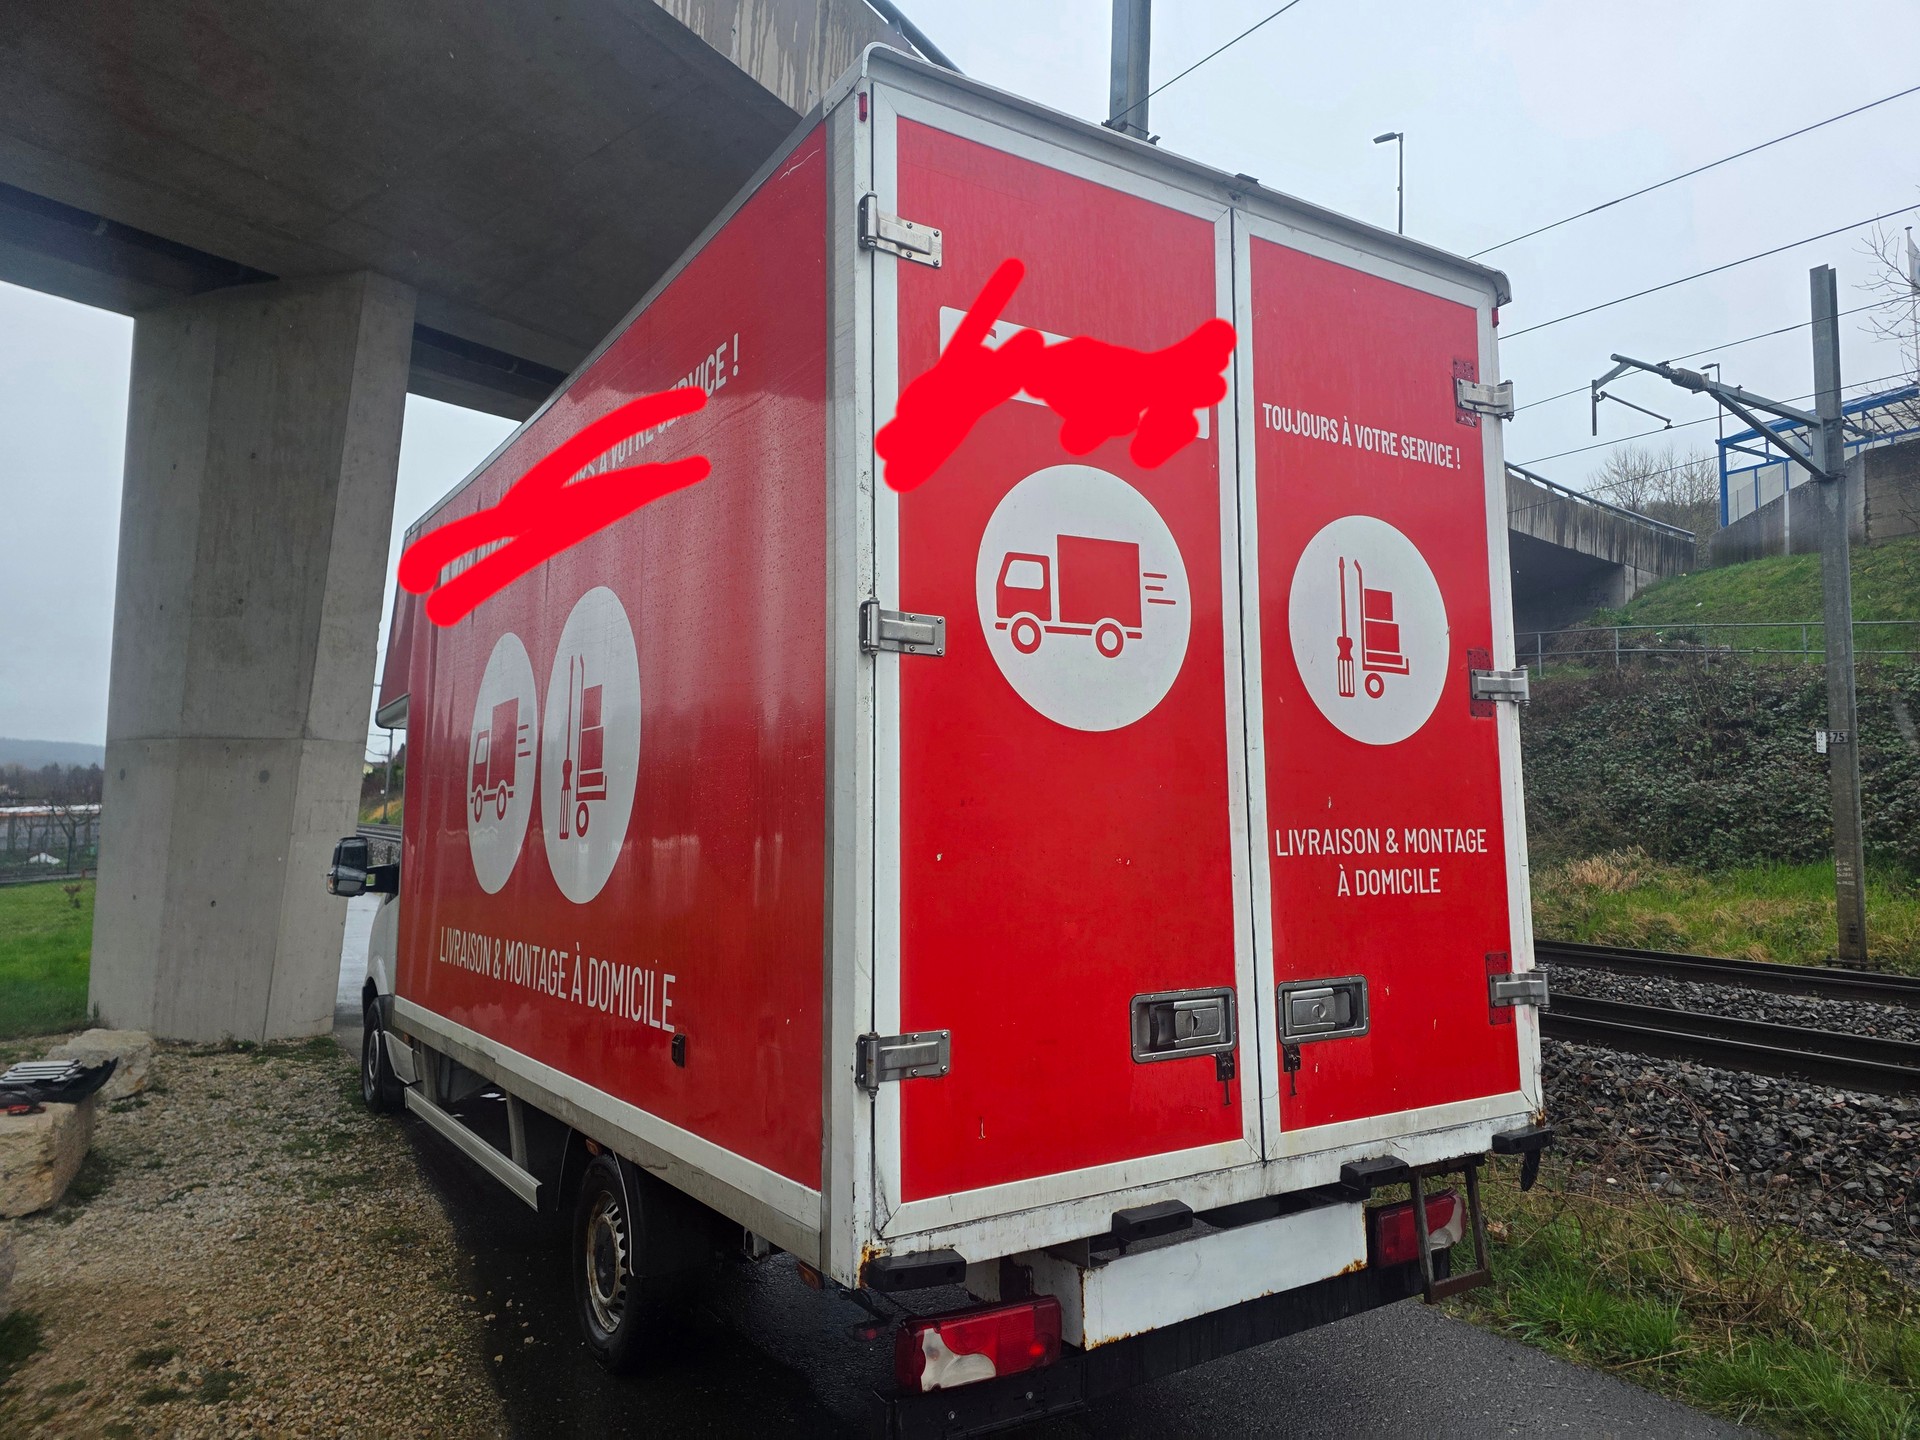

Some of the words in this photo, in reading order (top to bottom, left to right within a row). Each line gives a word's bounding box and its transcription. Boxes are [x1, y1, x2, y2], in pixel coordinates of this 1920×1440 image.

[733, 332, 739, 377] !
[1262, 402, 1339, 443] TOUJOURS
[1342, 415, 1352, 447] À
[1354, 423, 1399, 457] VOTRE
[1401, 434, 1454, 469] SERVICE
[1456, 447, 1461, 470] !
[1832, 732, 1845, 743] 75
[1275, 827, 1380, 857] LIVRAISON
[1385, 827, 1400, 854] &
[1404, 828, 1488, 854] MONTAGE
[1337, 863, 1351, 897] À
[1355, 868, 1441, 896] DOMICILE
[439, 926, 492, 977] LIVRAISON
[493, 937, 501, 980] &
[503, 938, 569, 1000] MONTAGE
[570, 941, 583, 1005] À
[587, 957, 676, 1033] DOMICILE
